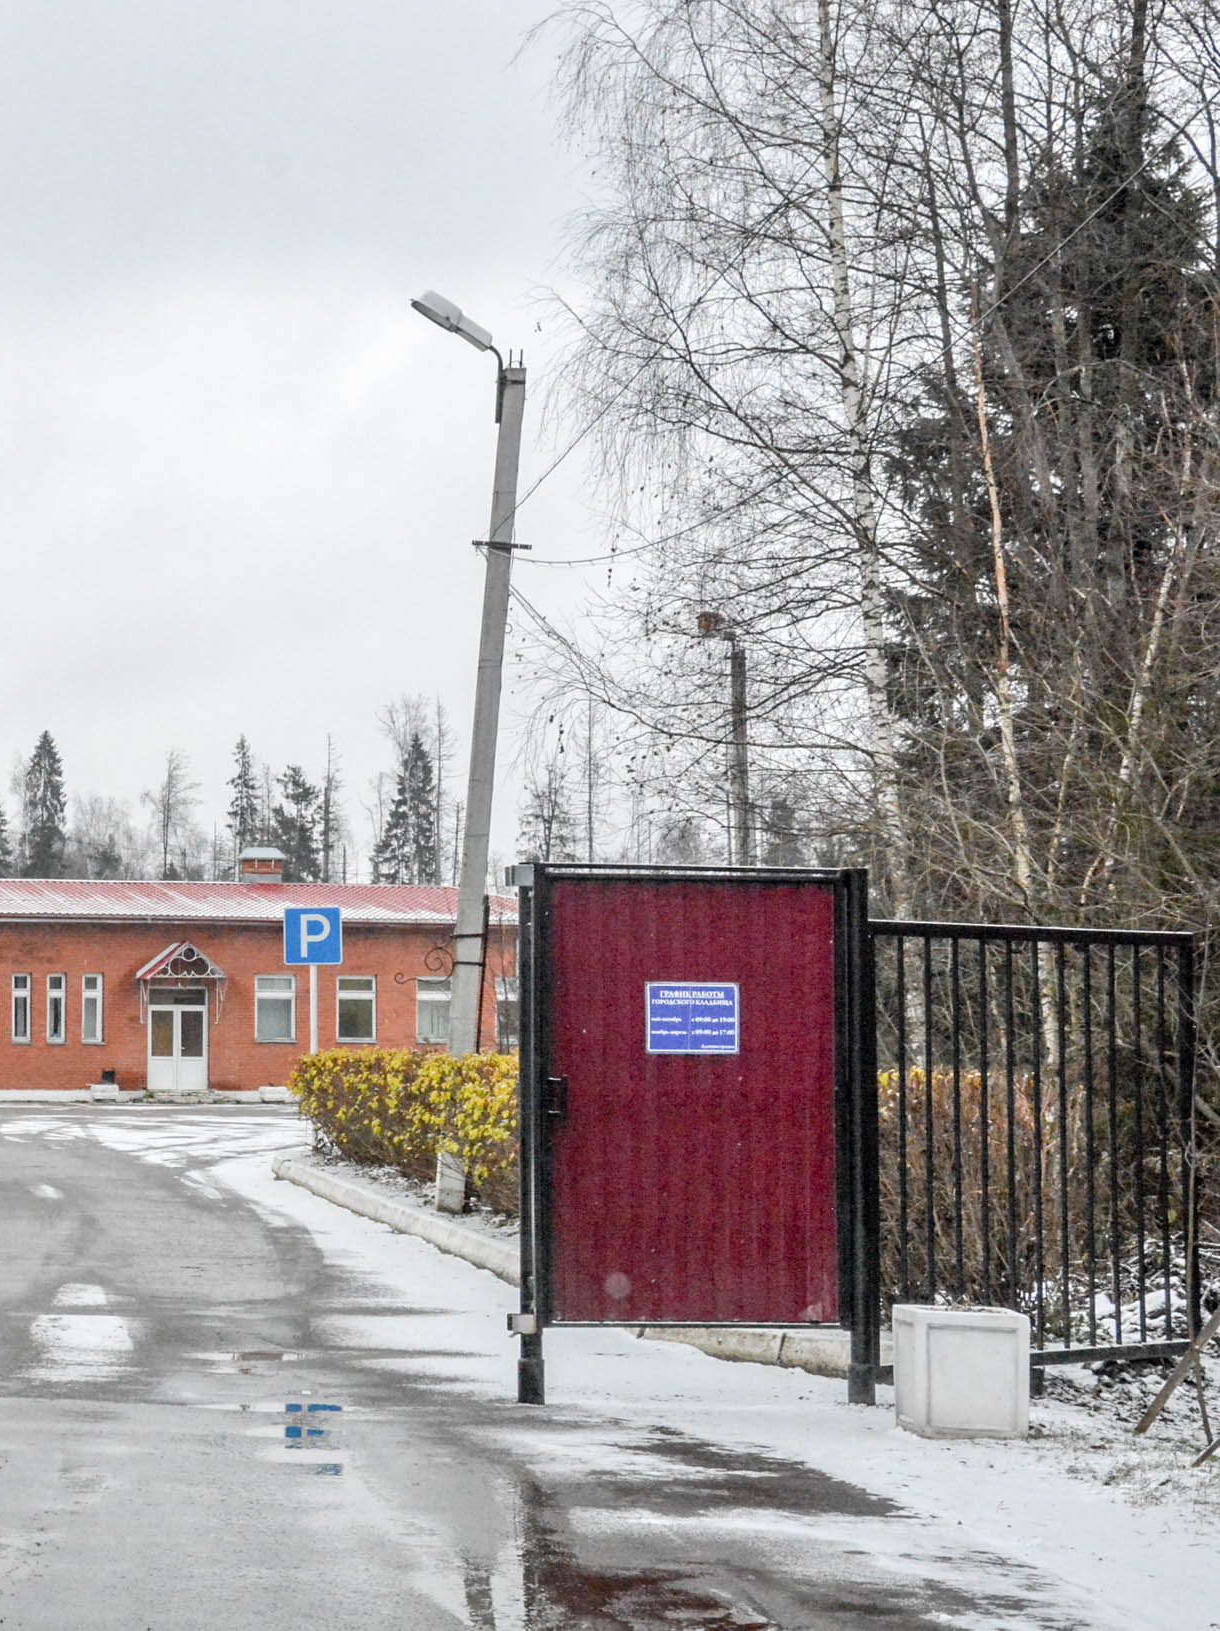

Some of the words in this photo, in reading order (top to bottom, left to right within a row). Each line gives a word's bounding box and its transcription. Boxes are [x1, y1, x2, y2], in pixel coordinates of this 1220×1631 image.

[300, 913, 331, 958] P
[659, 990, 691, 998] ГРАФИК
[692, 990, 724, 998] РАБОТЫ
